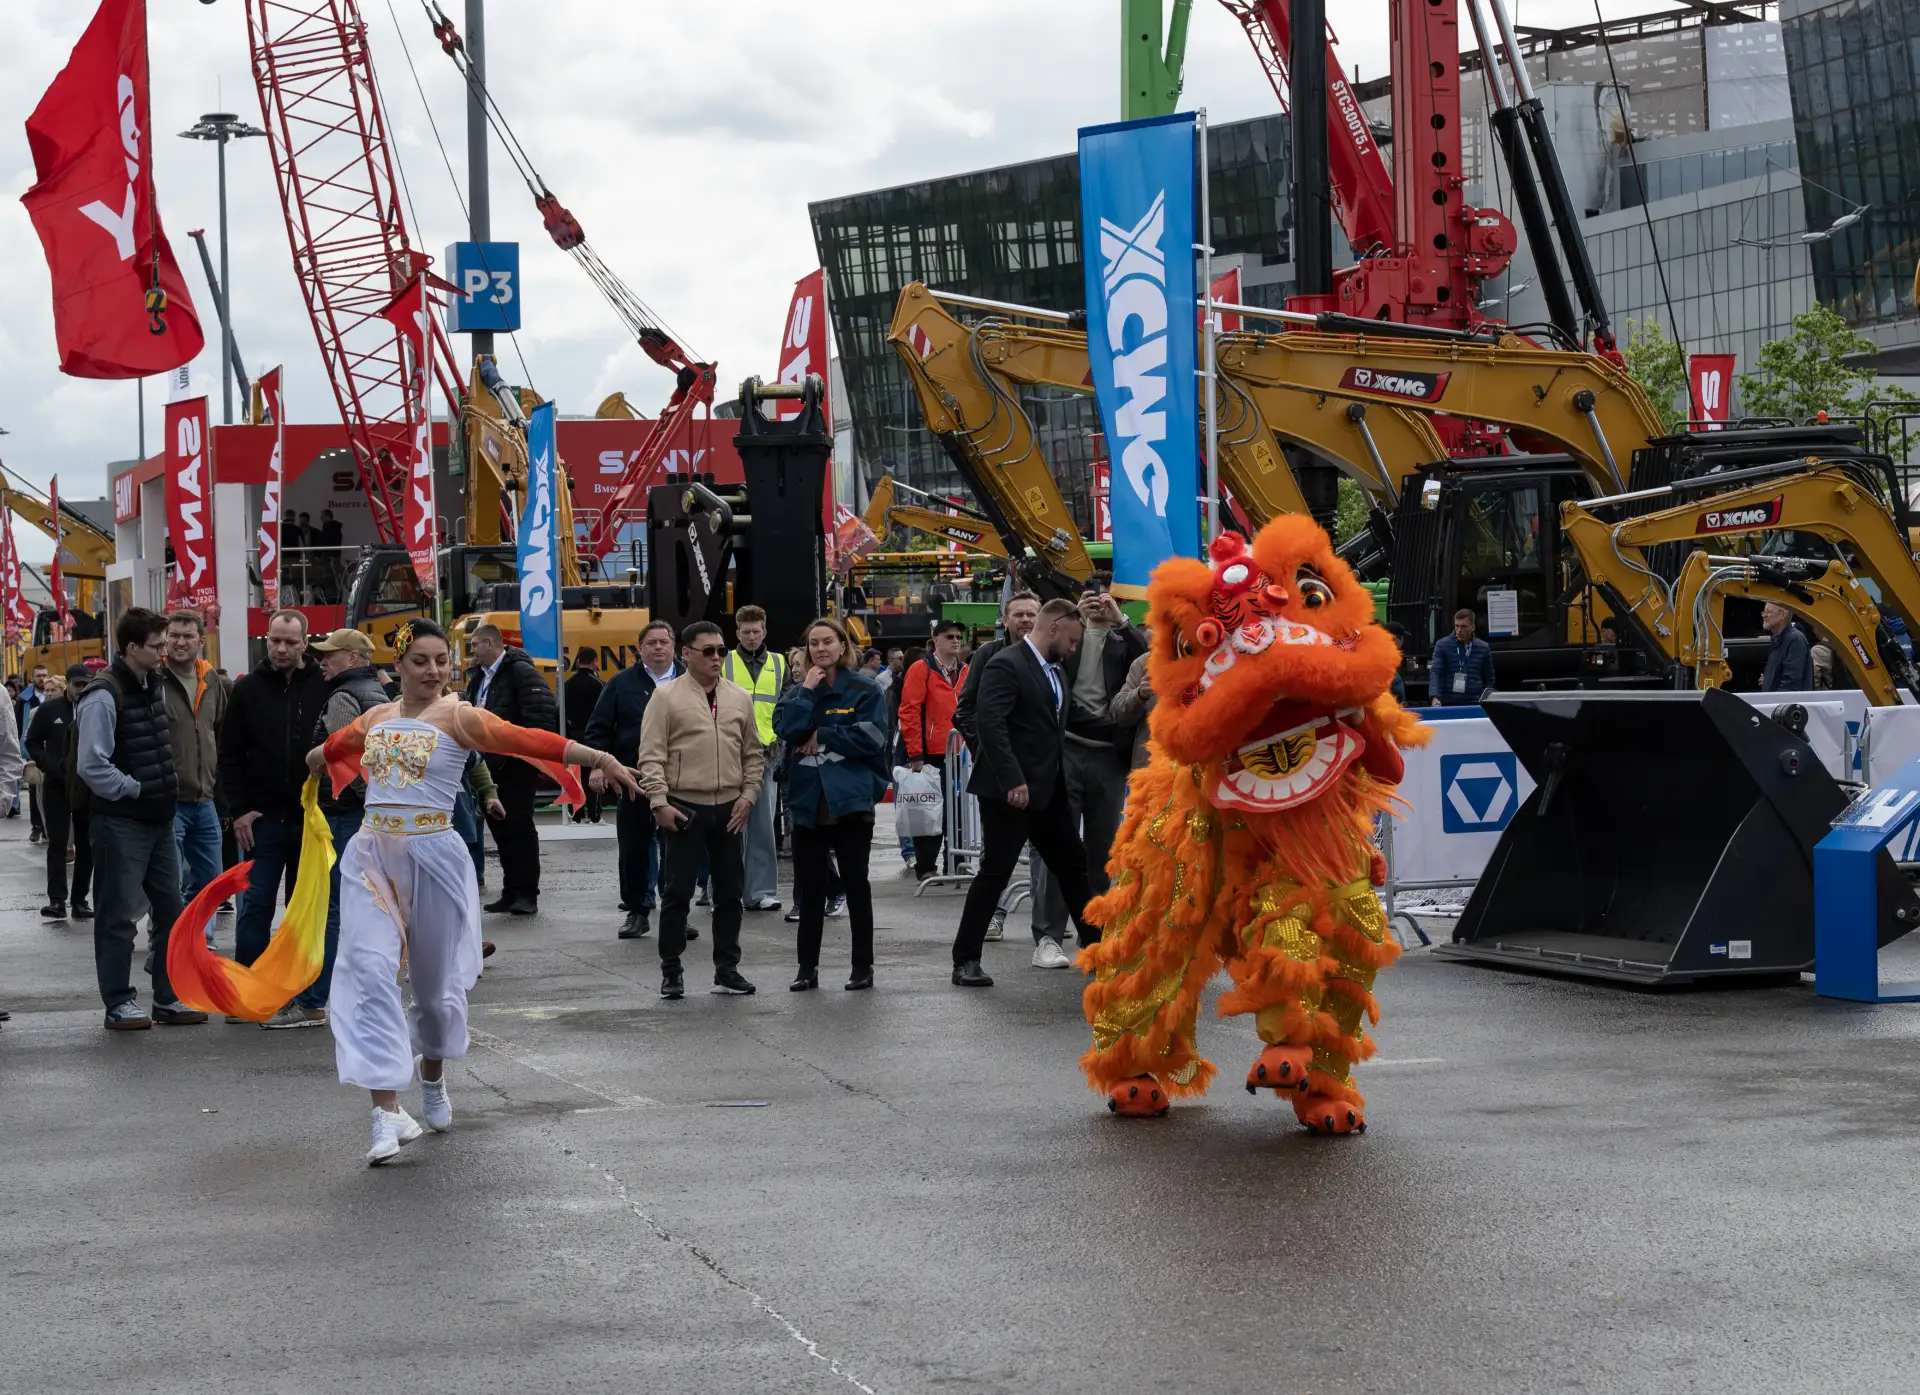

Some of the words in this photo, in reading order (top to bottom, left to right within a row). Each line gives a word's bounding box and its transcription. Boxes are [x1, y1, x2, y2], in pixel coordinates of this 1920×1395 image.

[1331, 80, 1370, 156] STC300T5.1
[464, 269, 513, 304] P3
[1371, 373, 1427, 398] XCMG
[115, 473, 133, 519] SANY
[947, 526, 974, 541] SANY
[1721, 509, 1767, 527] XCMG
[692, 540, 711, 596] XCMG
